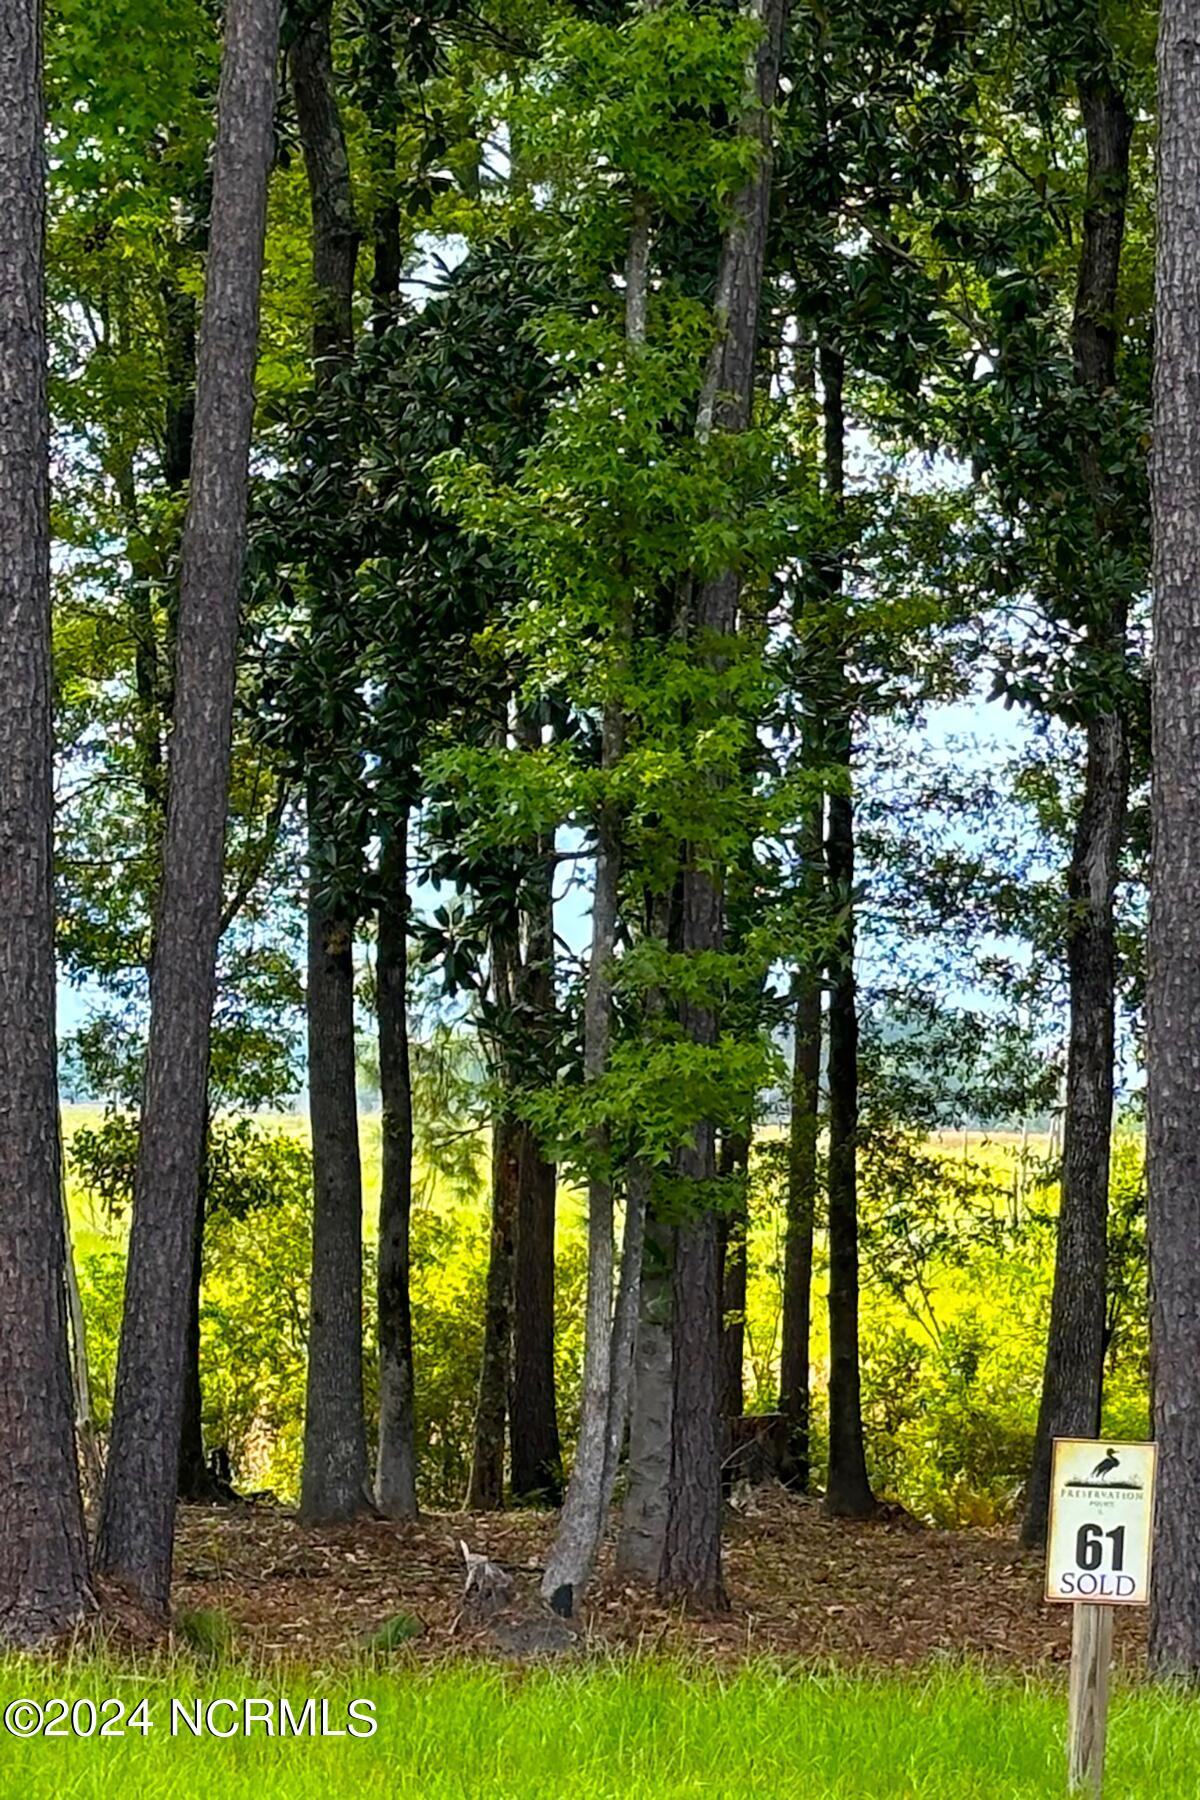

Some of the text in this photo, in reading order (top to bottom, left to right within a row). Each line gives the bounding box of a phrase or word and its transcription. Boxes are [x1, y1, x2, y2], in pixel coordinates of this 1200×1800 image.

[1060, 1489, 1144, 1501] PRESERVATION
[1075, 1523, 1125, 1571] 61
[1060, 1572, 1136, 1597] SOLD
